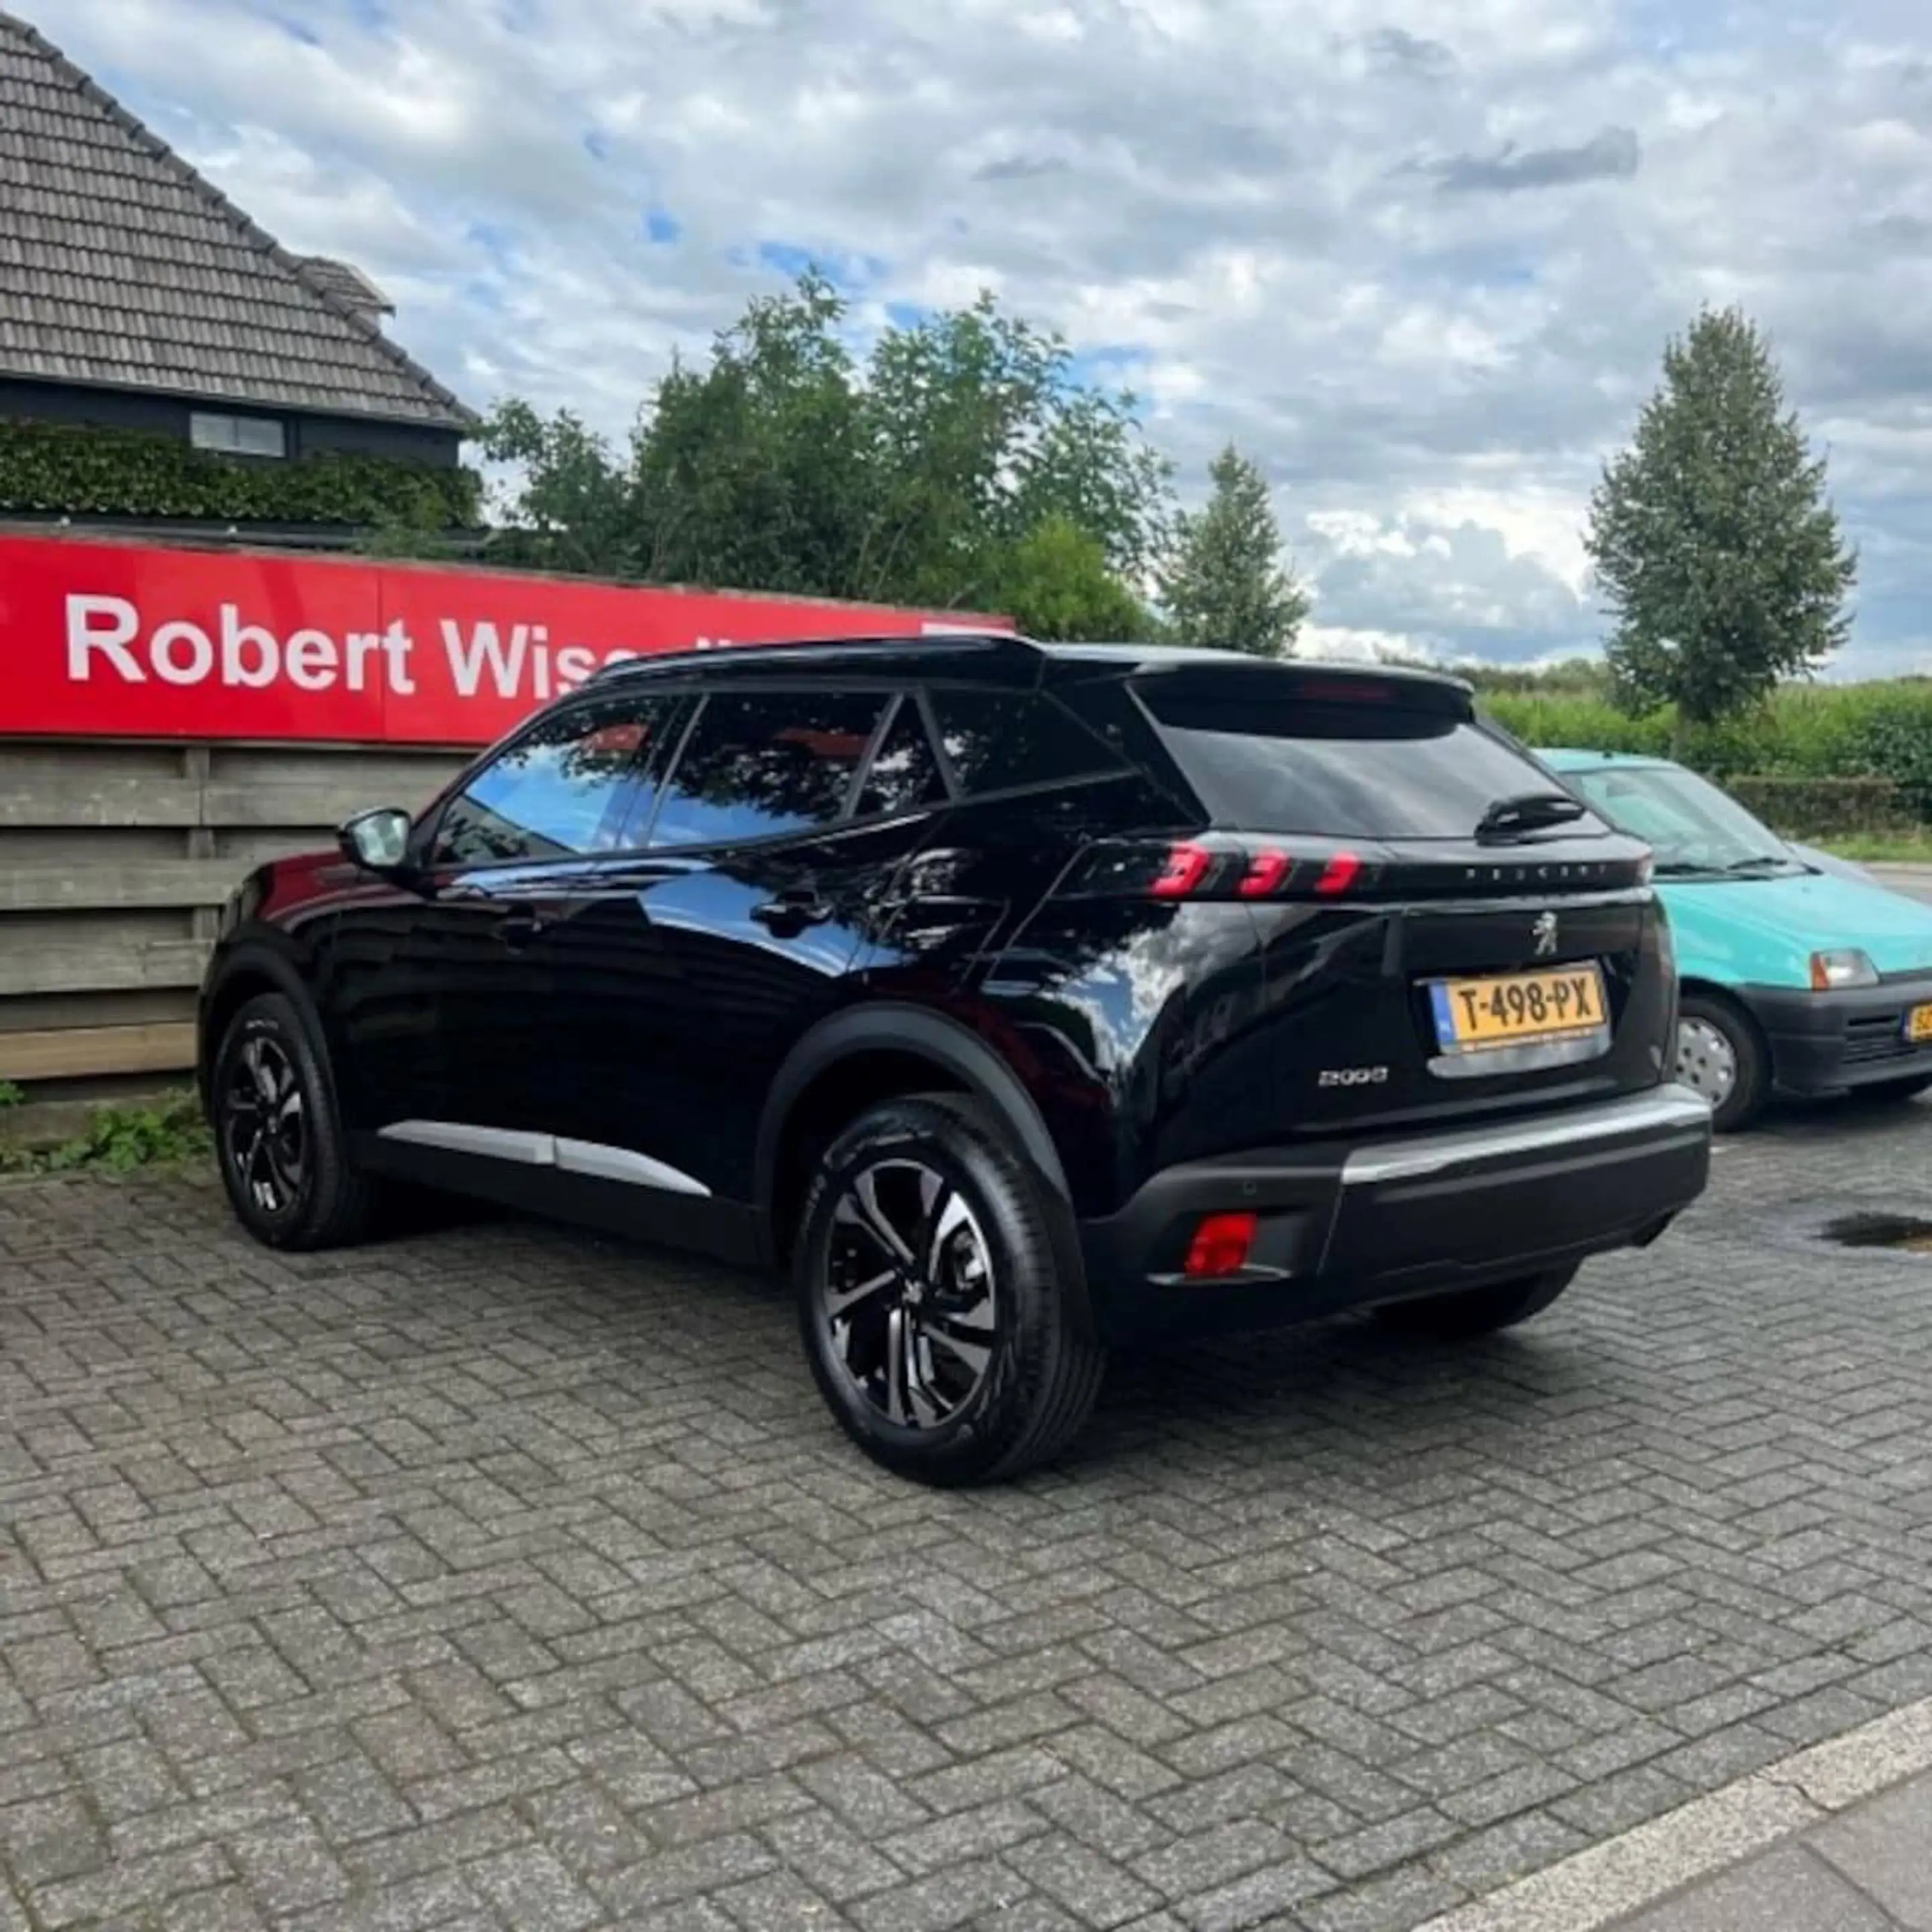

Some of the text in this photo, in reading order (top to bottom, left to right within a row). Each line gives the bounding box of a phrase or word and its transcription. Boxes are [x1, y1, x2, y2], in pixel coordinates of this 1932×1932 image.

[66, 594, 733, 699] Robert Wis
[1458, 978, 1591, 1031] T-498-PX
